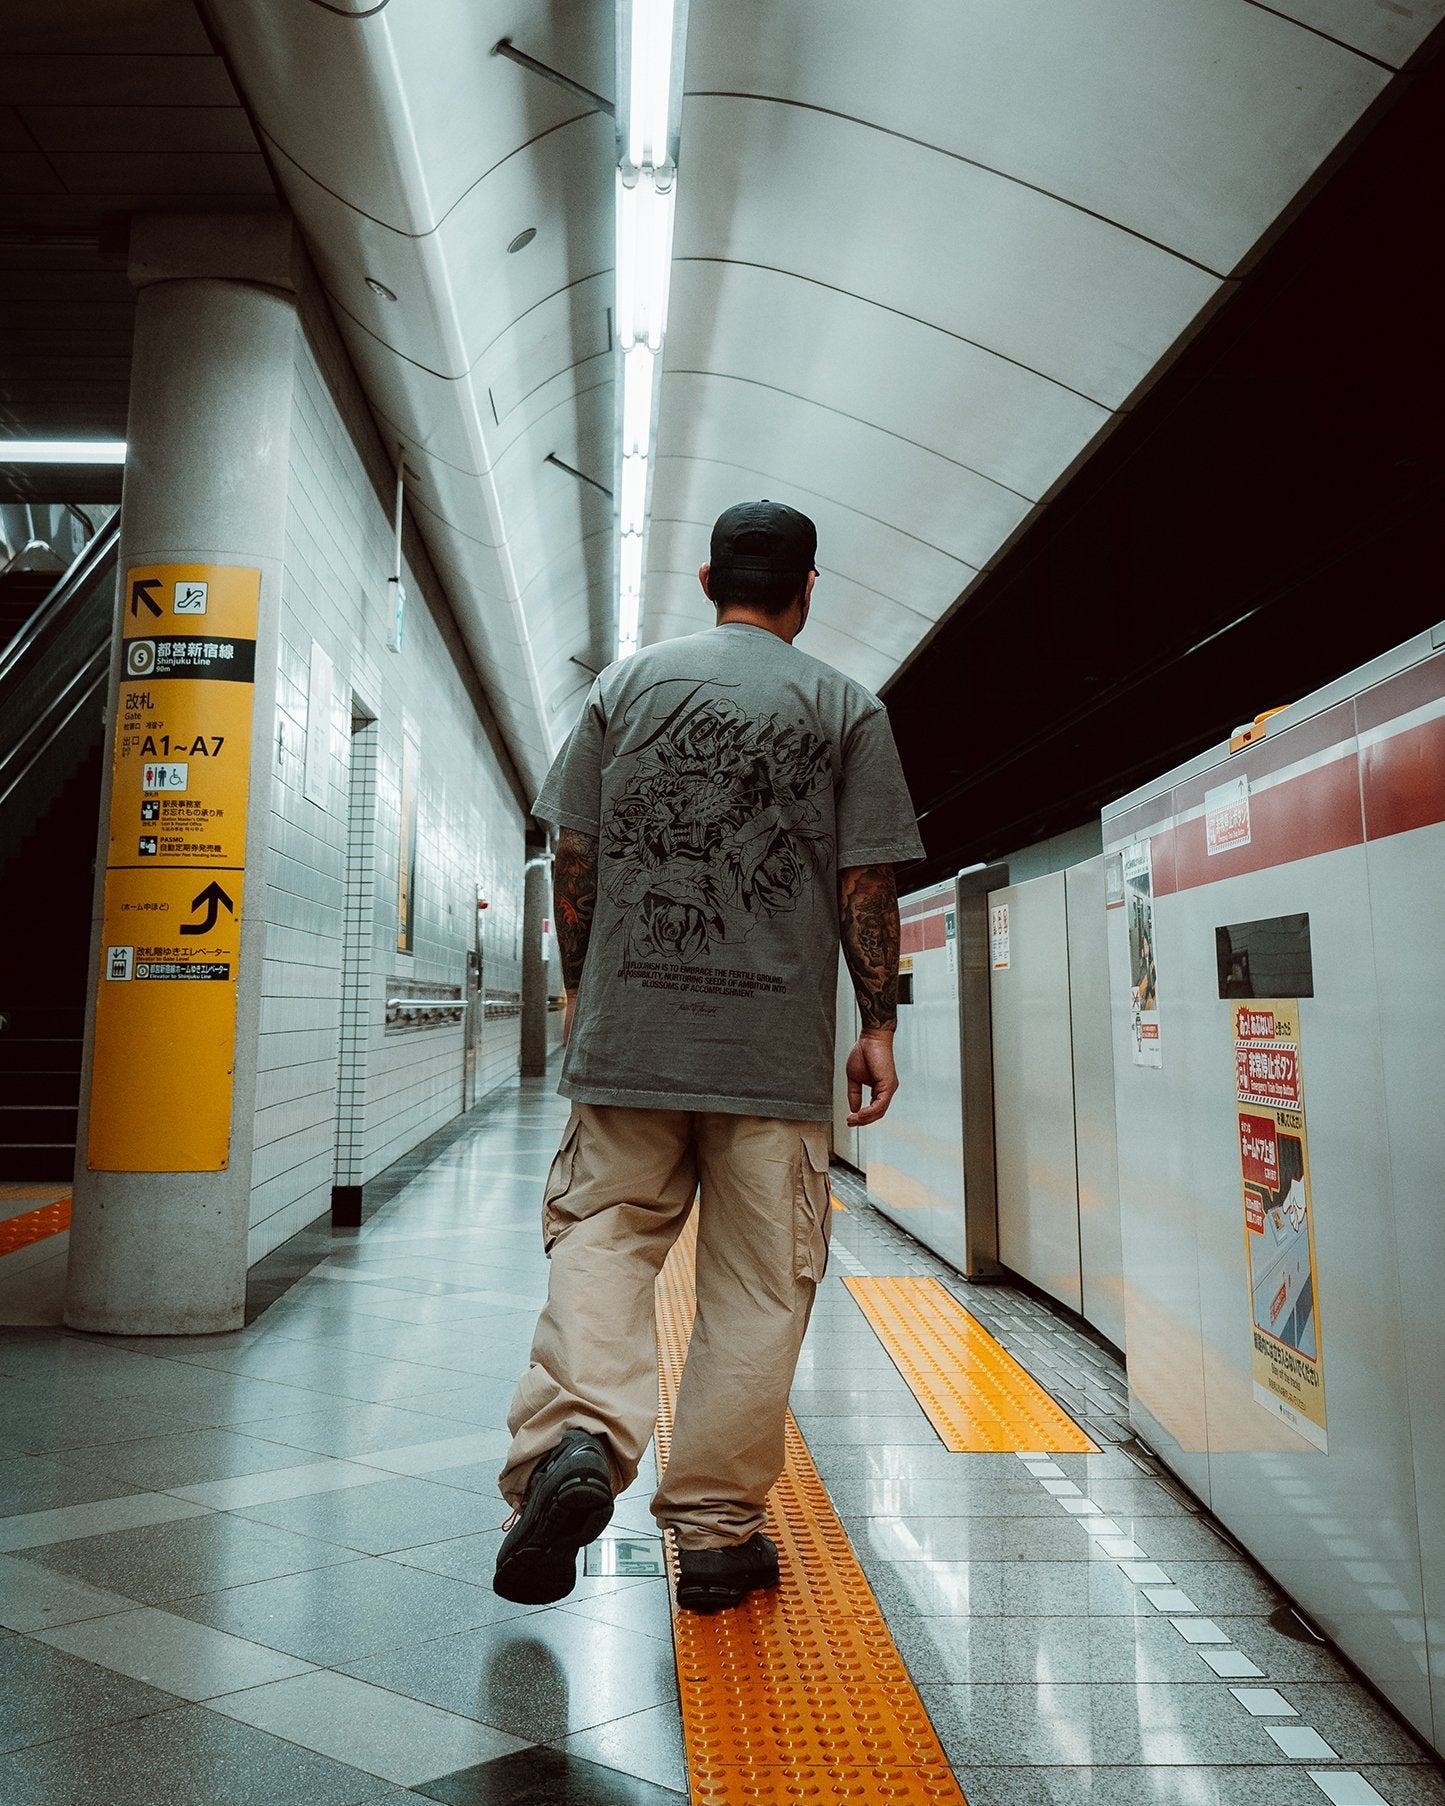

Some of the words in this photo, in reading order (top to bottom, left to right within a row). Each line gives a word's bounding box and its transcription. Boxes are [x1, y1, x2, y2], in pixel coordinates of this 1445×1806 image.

[157, 642, 234, 660] 都営新宿線
[156, 657, 191, 666] Shinjuku
[193, 658, 211, 666] Line
[125, 692, 155, 710] 改札
[124, 712, 142, 720] Gate
[136, 946, 231, 957] 改札階ゆきエレベーター
[661, 963, 669, 971] IS
[669, 964, 679, 973] TO
[680, 965, 714, 977] EMBRACE
[714, 968, 728, 978] THE
[728, 970, 756, 980] FERTILE
[756, 973, 783, 985] GROUND
[665, 972, 703, 984] NURTURING
[704, 976, 727, 987] SEEDS
[727, 979, 737, 988] OF
[737, 980, 771, 992] AMBITION
[771, 983, 787, 994] INTO
[641, 979, 679, 991] BLOSSOMS
[680, 983, 690, 992] OF
[1248, 1051, 1293, 1080] 非常停止ボタン
